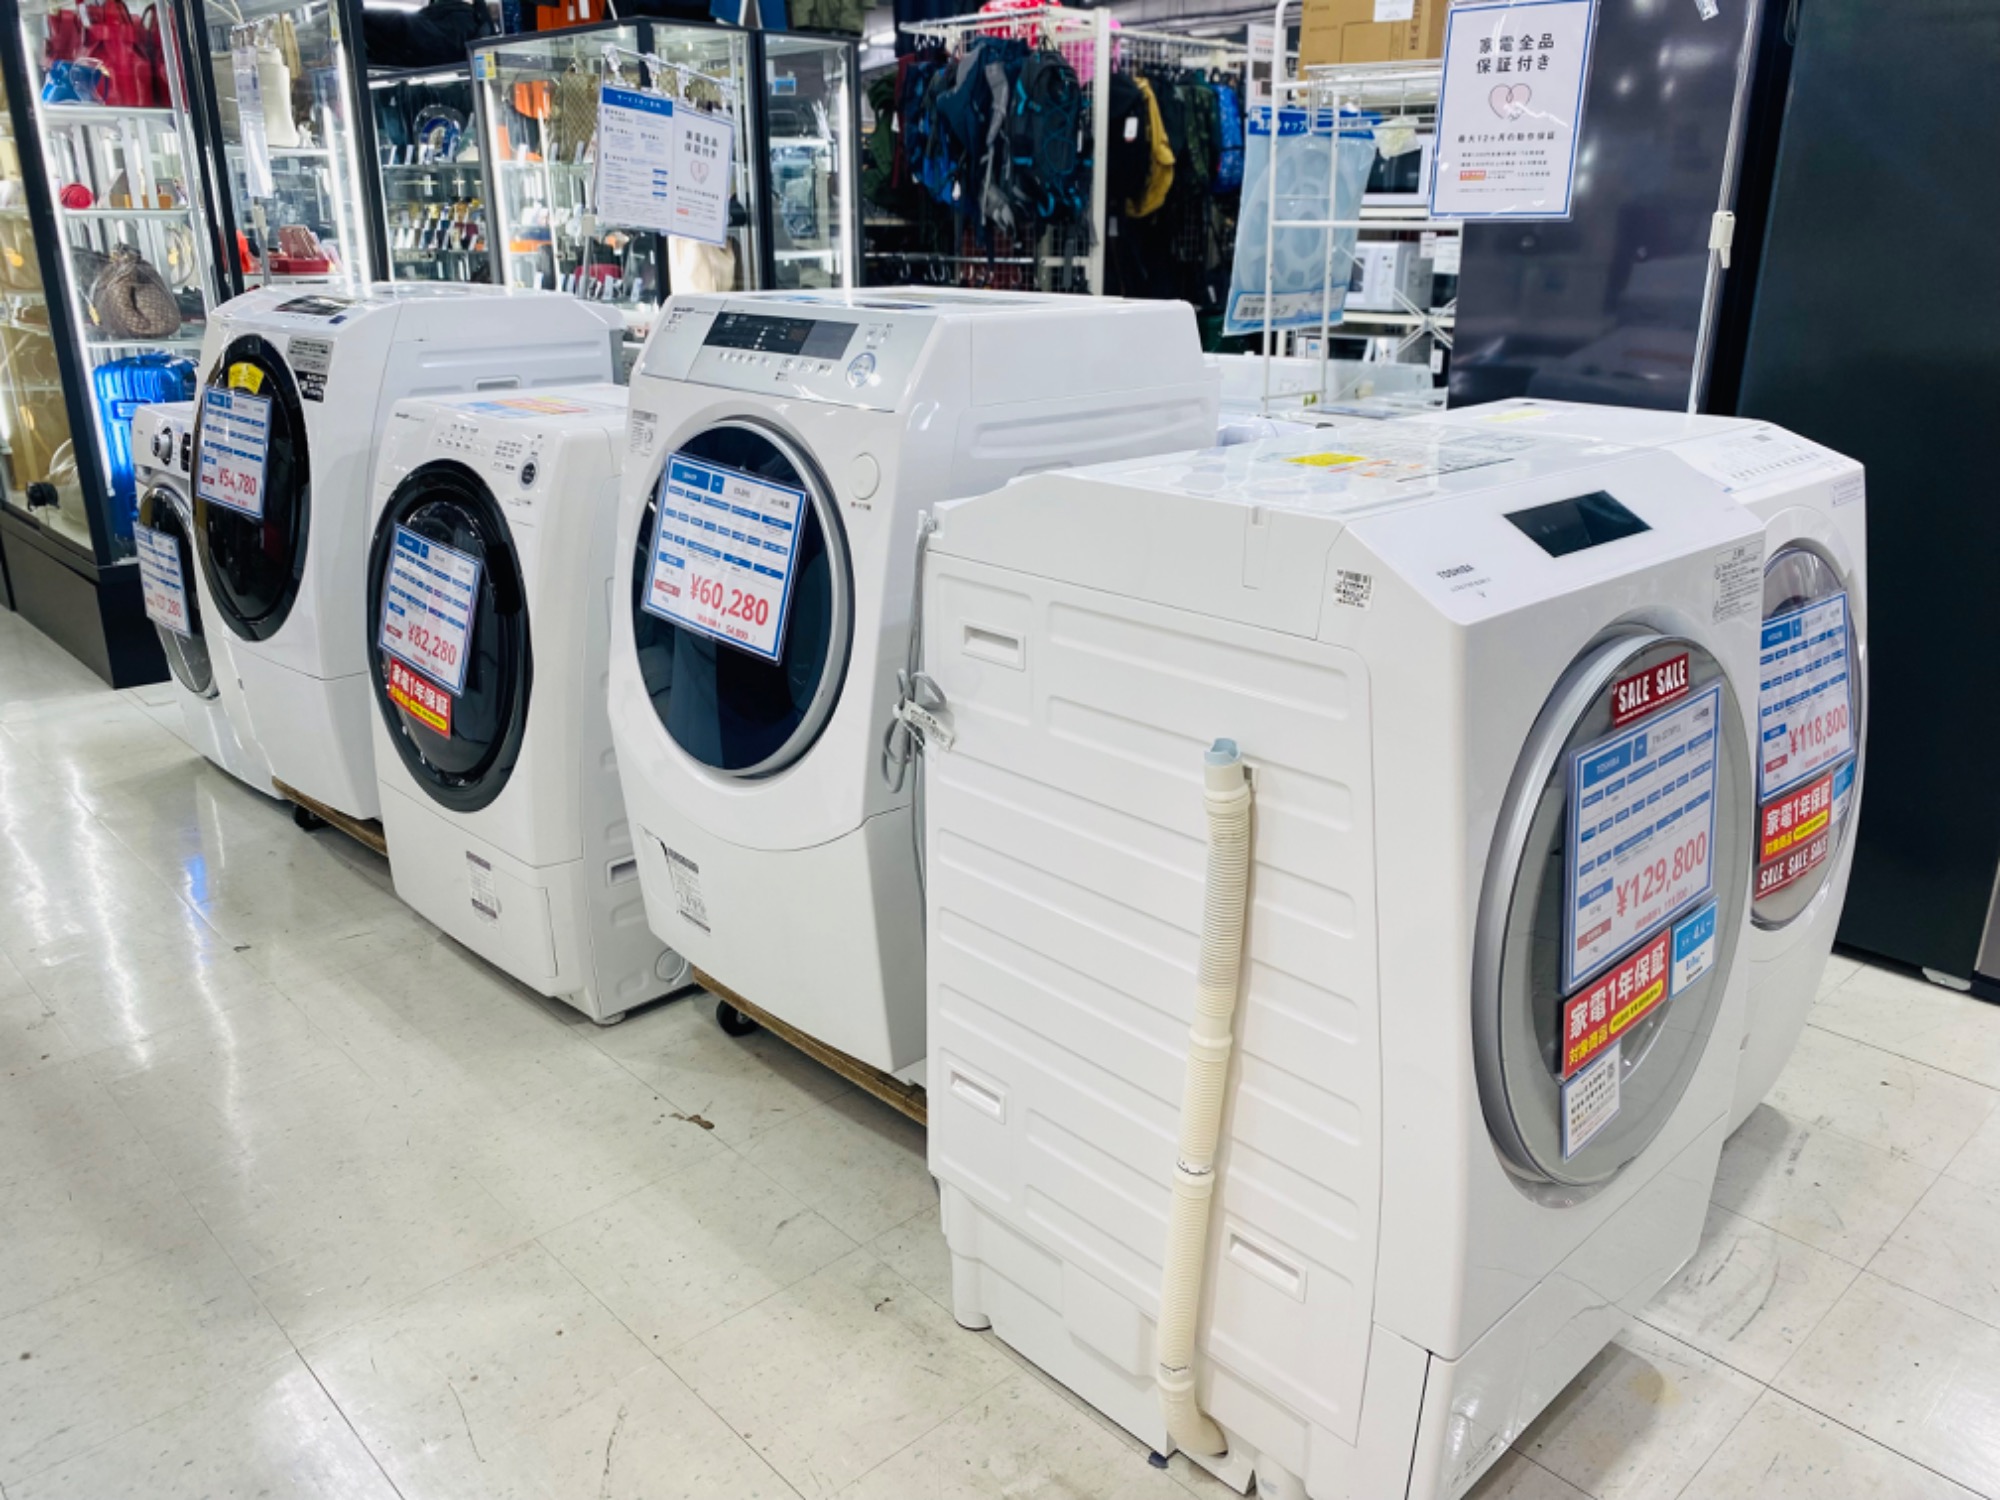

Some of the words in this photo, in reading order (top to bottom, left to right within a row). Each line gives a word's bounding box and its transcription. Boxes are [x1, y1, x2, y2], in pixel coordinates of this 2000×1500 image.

[1476, 54, 1550, 74] 保証付き
[1479, 33, 1554, 54] 家電全品
[218, 466, 257, 497] ¥54,780
[690, 573, 769, 626] ¥60,280
[408, 621, 457, 666] ¥82,280
[1618, 675, 1650, 713] SALE
[1656, 659, 1686, 696] SALE
[1789, 704, 1848, 756] ¥118,800
[1766, 778, 1830, 836] 家電1年保証
[1616, 831, 1707, 917] ¥129,800
[1761, 862, 1784, 890] SALE
[1788, 848, 1808, 875] SALE
[1811, 834, 1828, 860] SALE
[1569, 940, 1665, 1040] 家電1年保証
